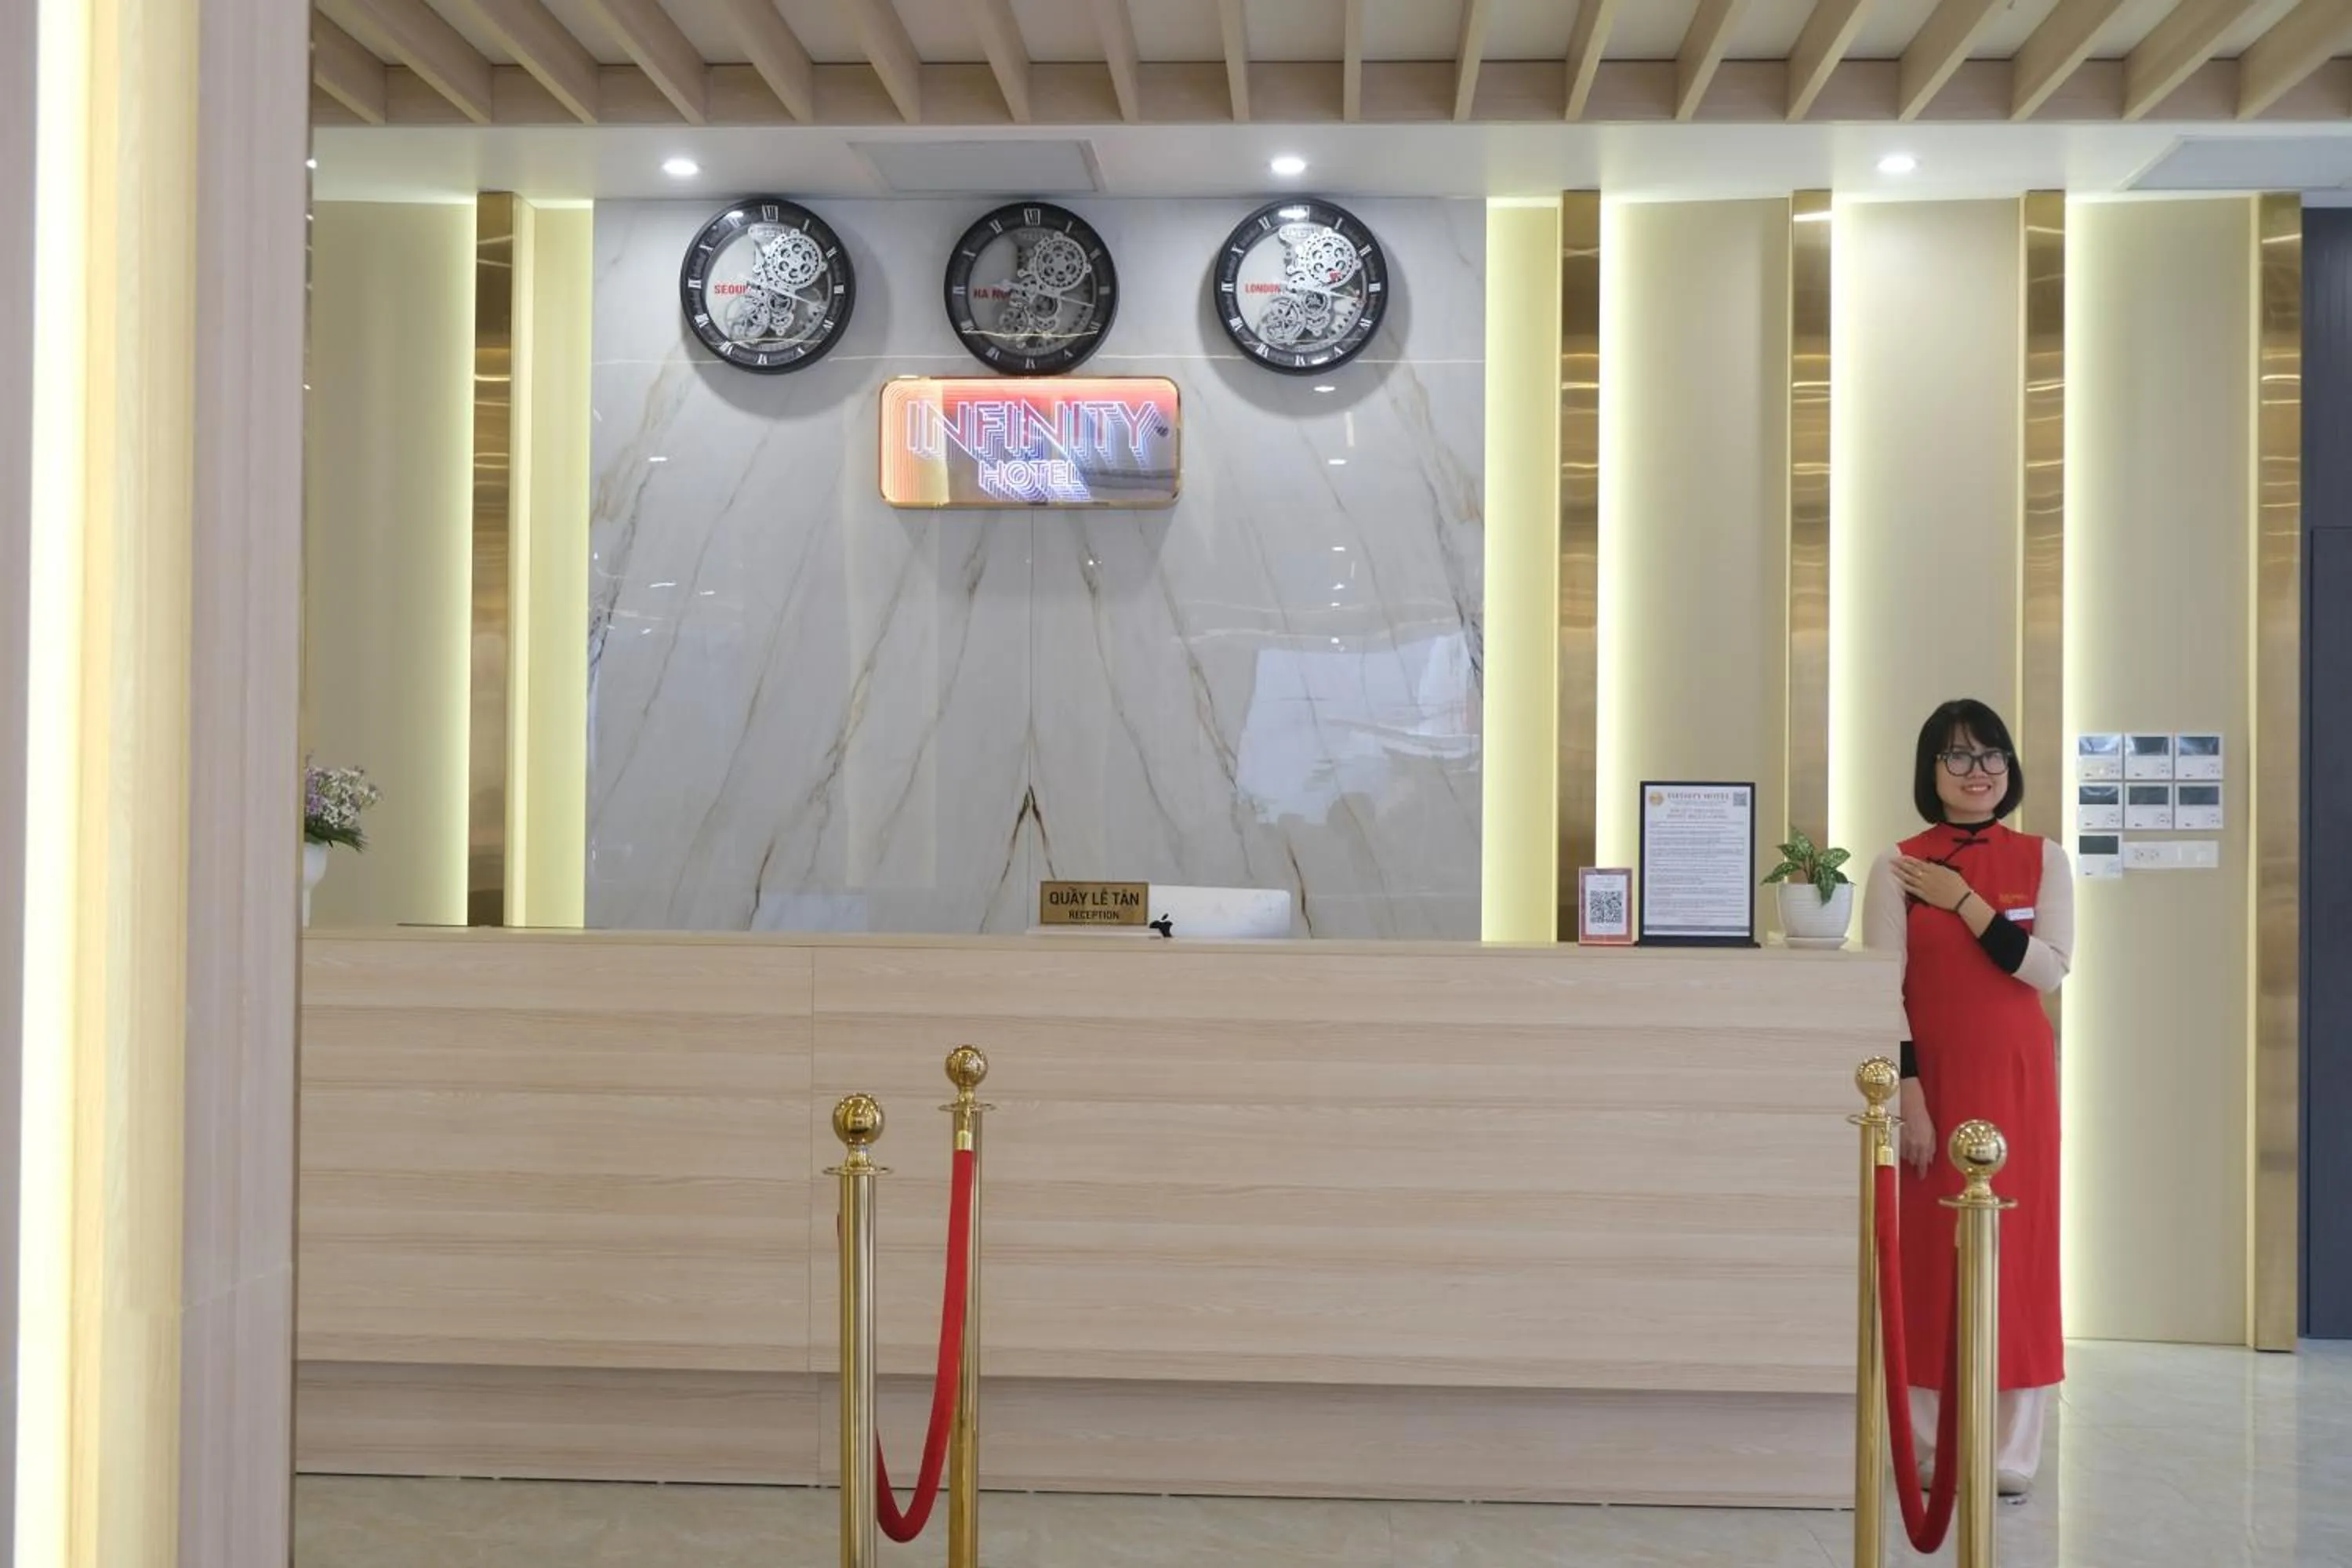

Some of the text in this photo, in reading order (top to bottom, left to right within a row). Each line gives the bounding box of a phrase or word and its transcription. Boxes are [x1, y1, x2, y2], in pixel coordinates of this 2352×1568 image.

[906, 398, 1159, 463] INFINITY
[978, 459, 1087, 494] HOTEL
[1069, 910, 1120, 920] RECEPTION
